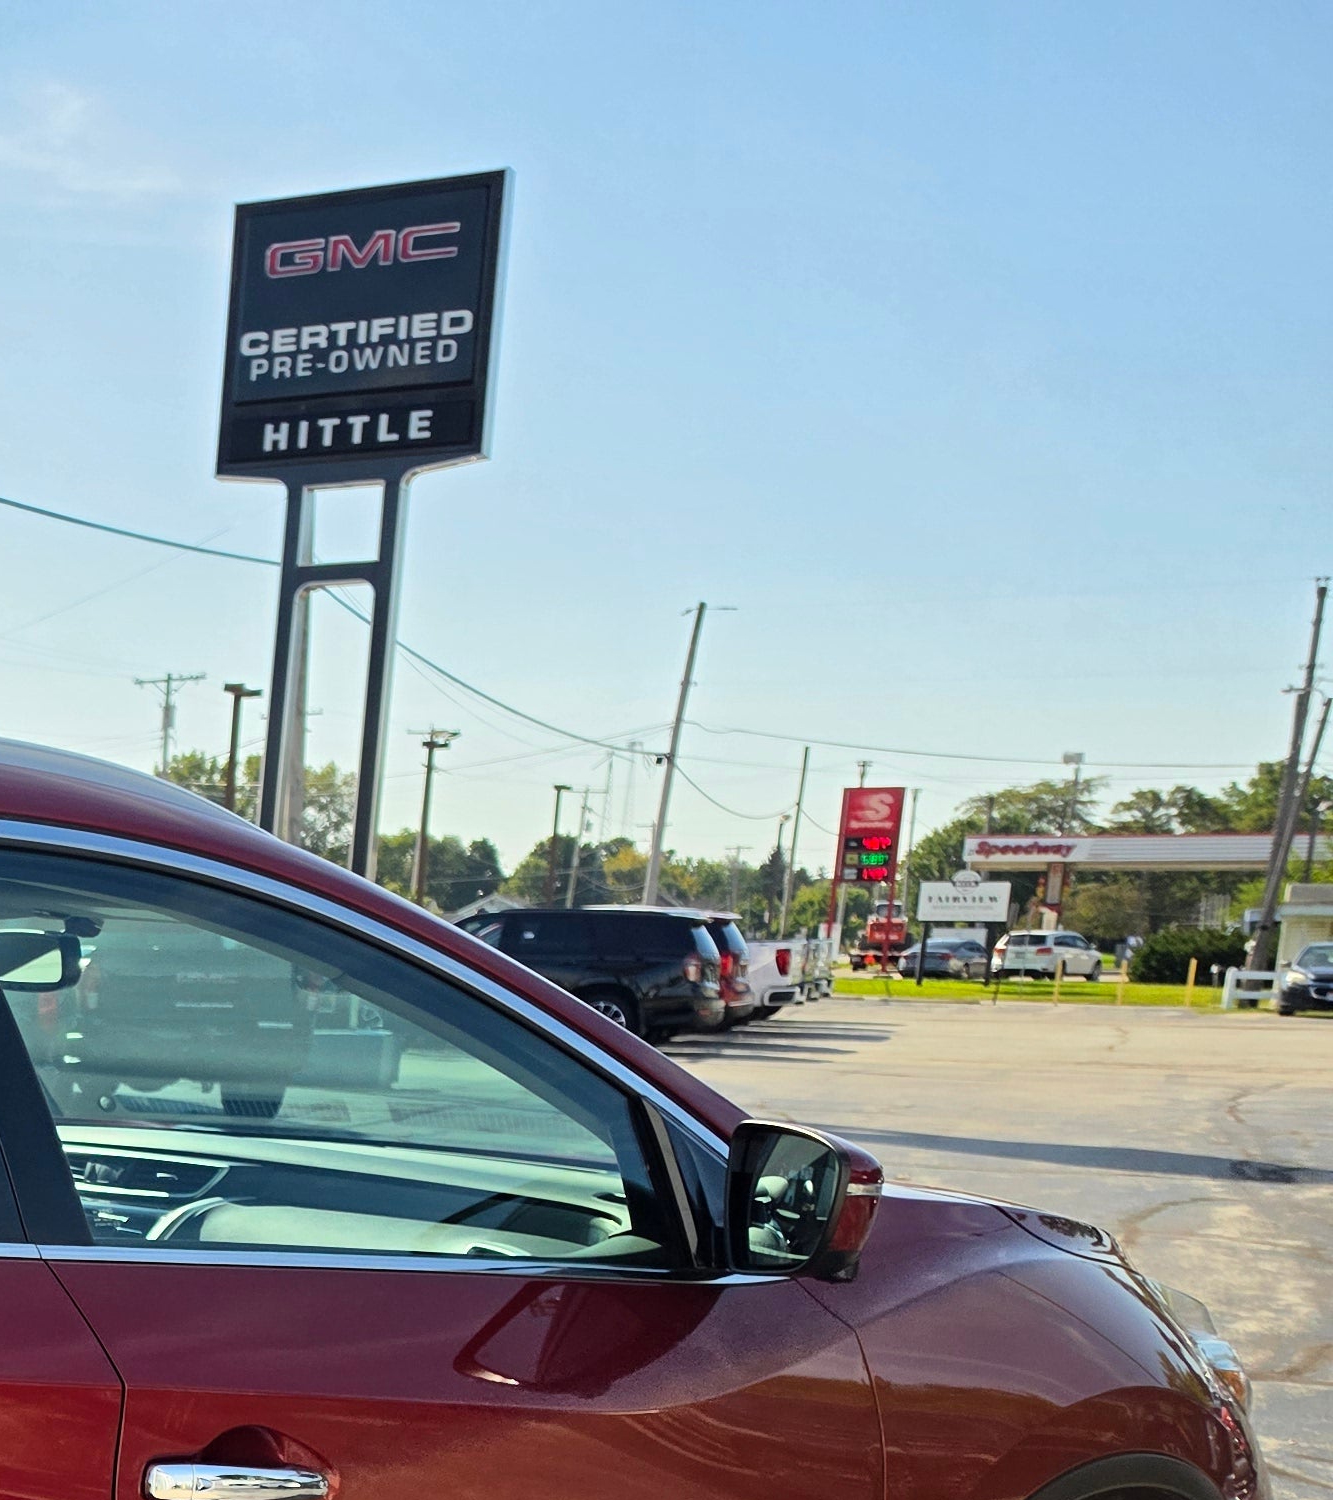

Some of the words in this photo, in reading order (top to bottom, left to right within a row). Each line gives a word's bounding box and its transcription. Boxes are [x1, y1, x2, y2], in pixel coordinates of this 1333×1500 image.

[264, 221, 461, 279] GMC
[240, 309, 474, 356] CERTIFIED
[249, 339, 458, 382] PRE-OWNED
[262, 409, 434, 452] HITTLE
[975, 841, 1077, 859] Speedway
